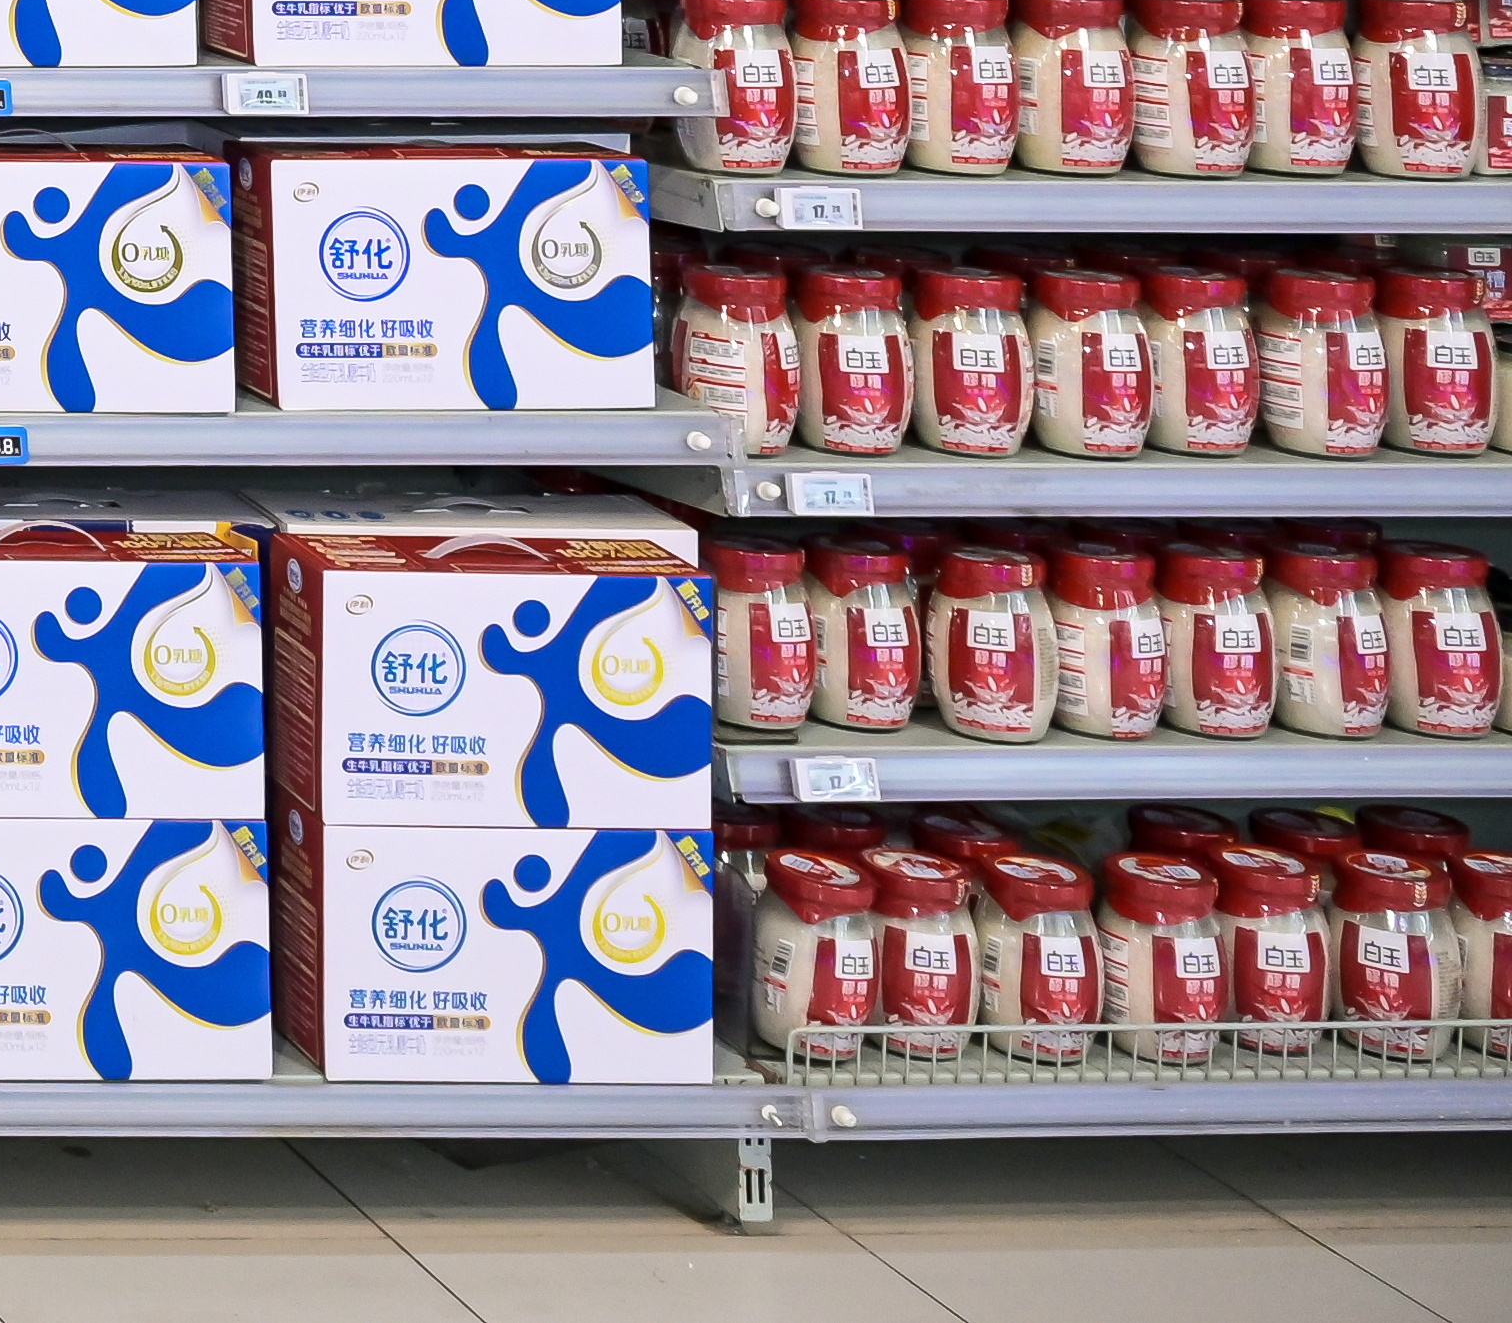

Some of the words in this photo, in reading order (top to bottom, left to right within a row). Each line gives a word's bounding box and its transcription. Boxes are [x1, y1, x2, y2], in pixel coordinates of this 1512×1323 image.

[740, 62, 778, 85] 白玉
[1090, 60, 1121, 83] 白玉
[1415, 66, 1452, 87] 白玉
[846, 348, 882, 370] 白玉
[1435, 346, 1471, 367] 白玉
[973, 620, 1014, 648] 白玉
[1444, 621, 1485, 647] 白玉
[387, 643, 449, 678] 舒化
[911, 947, 952, 968] 白玉
[1364, 946, 1406, 968] 白玉
